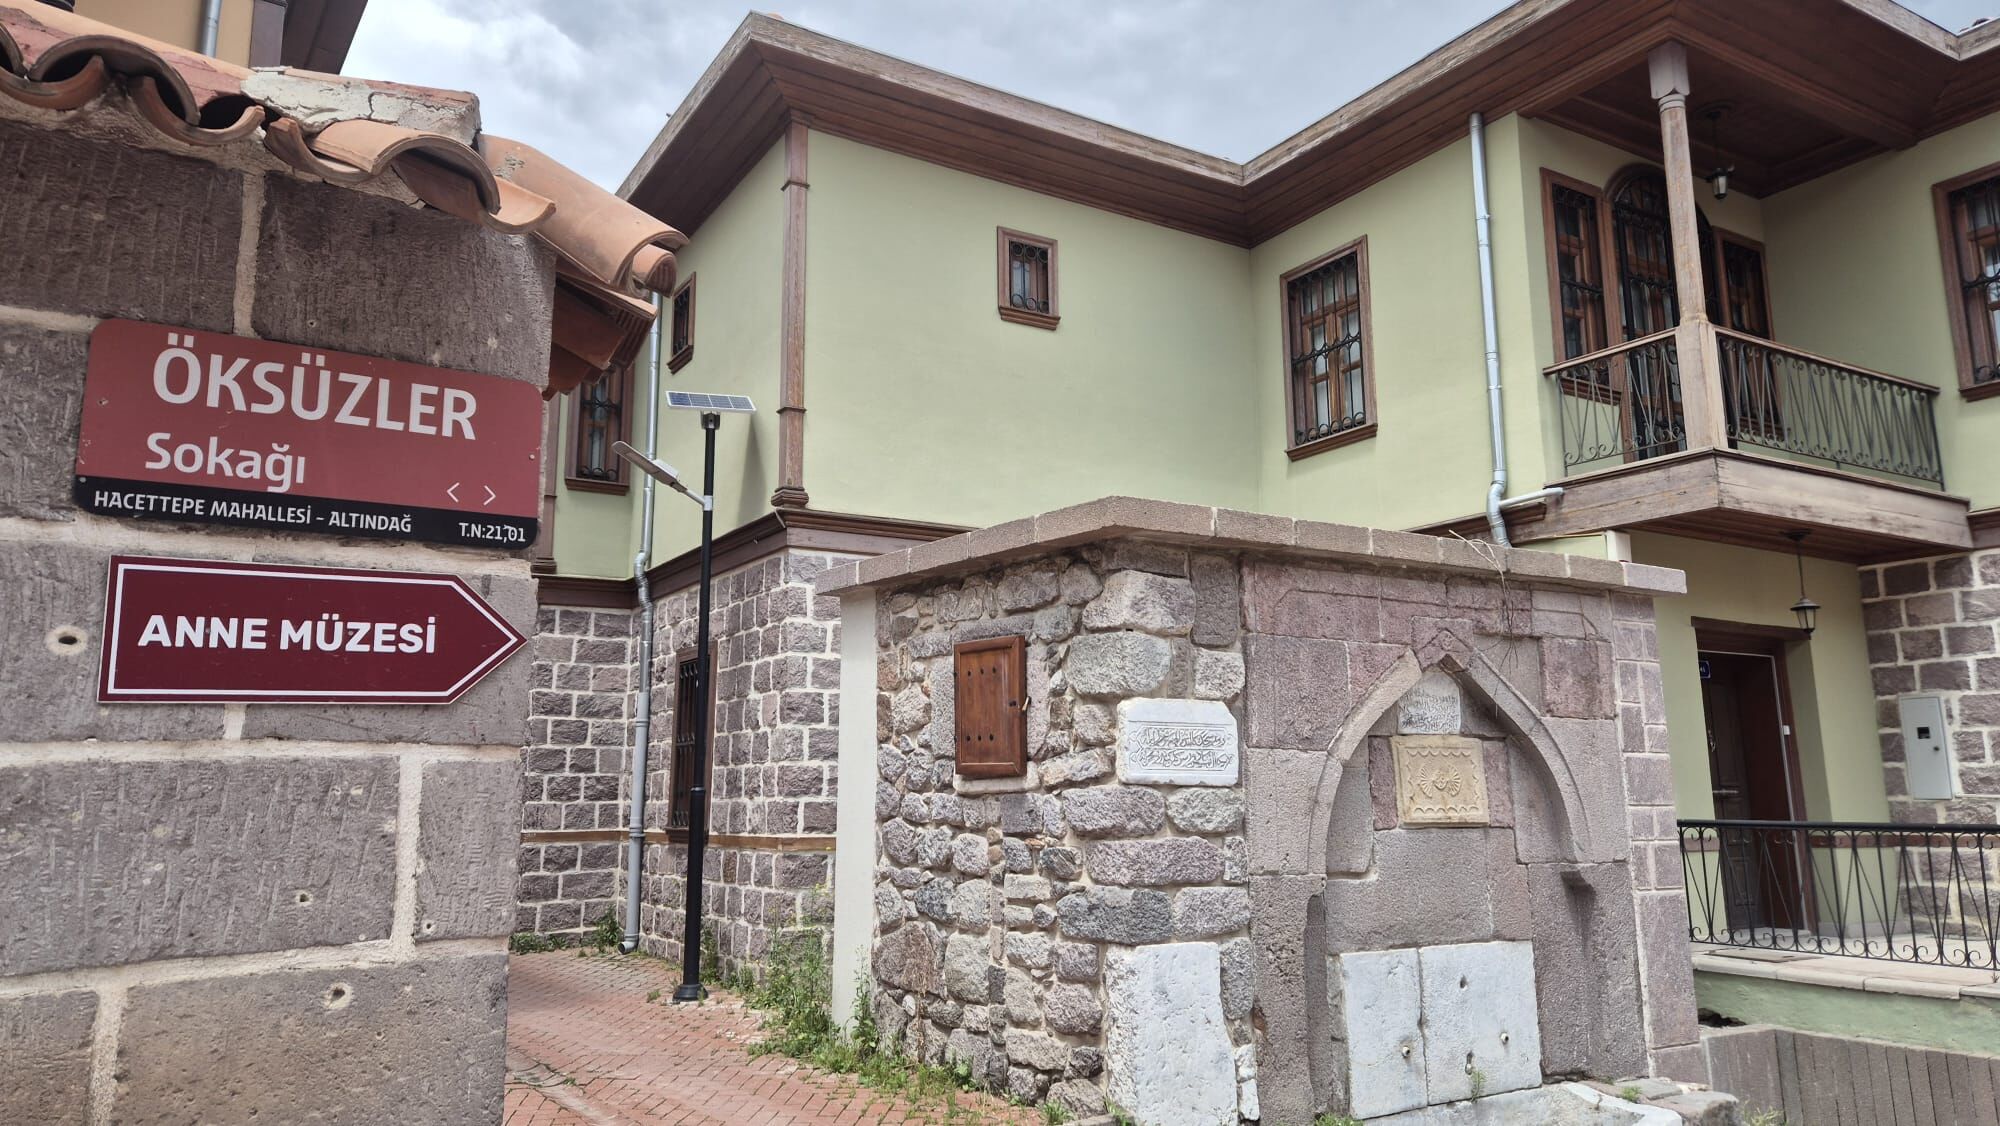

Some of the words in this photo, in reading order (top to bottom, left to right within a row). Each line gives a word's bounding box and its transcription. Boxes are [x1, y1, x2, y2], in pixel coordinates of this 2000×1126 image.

[153, 333, 477, 440] ÖKSÜZLER
[145, 432, 305, 493] Sokağı
[94, 490, 206, 515] HACETTEPE
[210, 500, 312, 525] MAHALLESİ
[328, 511, 412, 533] ALTINDAĞ
[138, 614, 268, 650] ANNE
[279, 613, 436, 654] MÜZESİ
